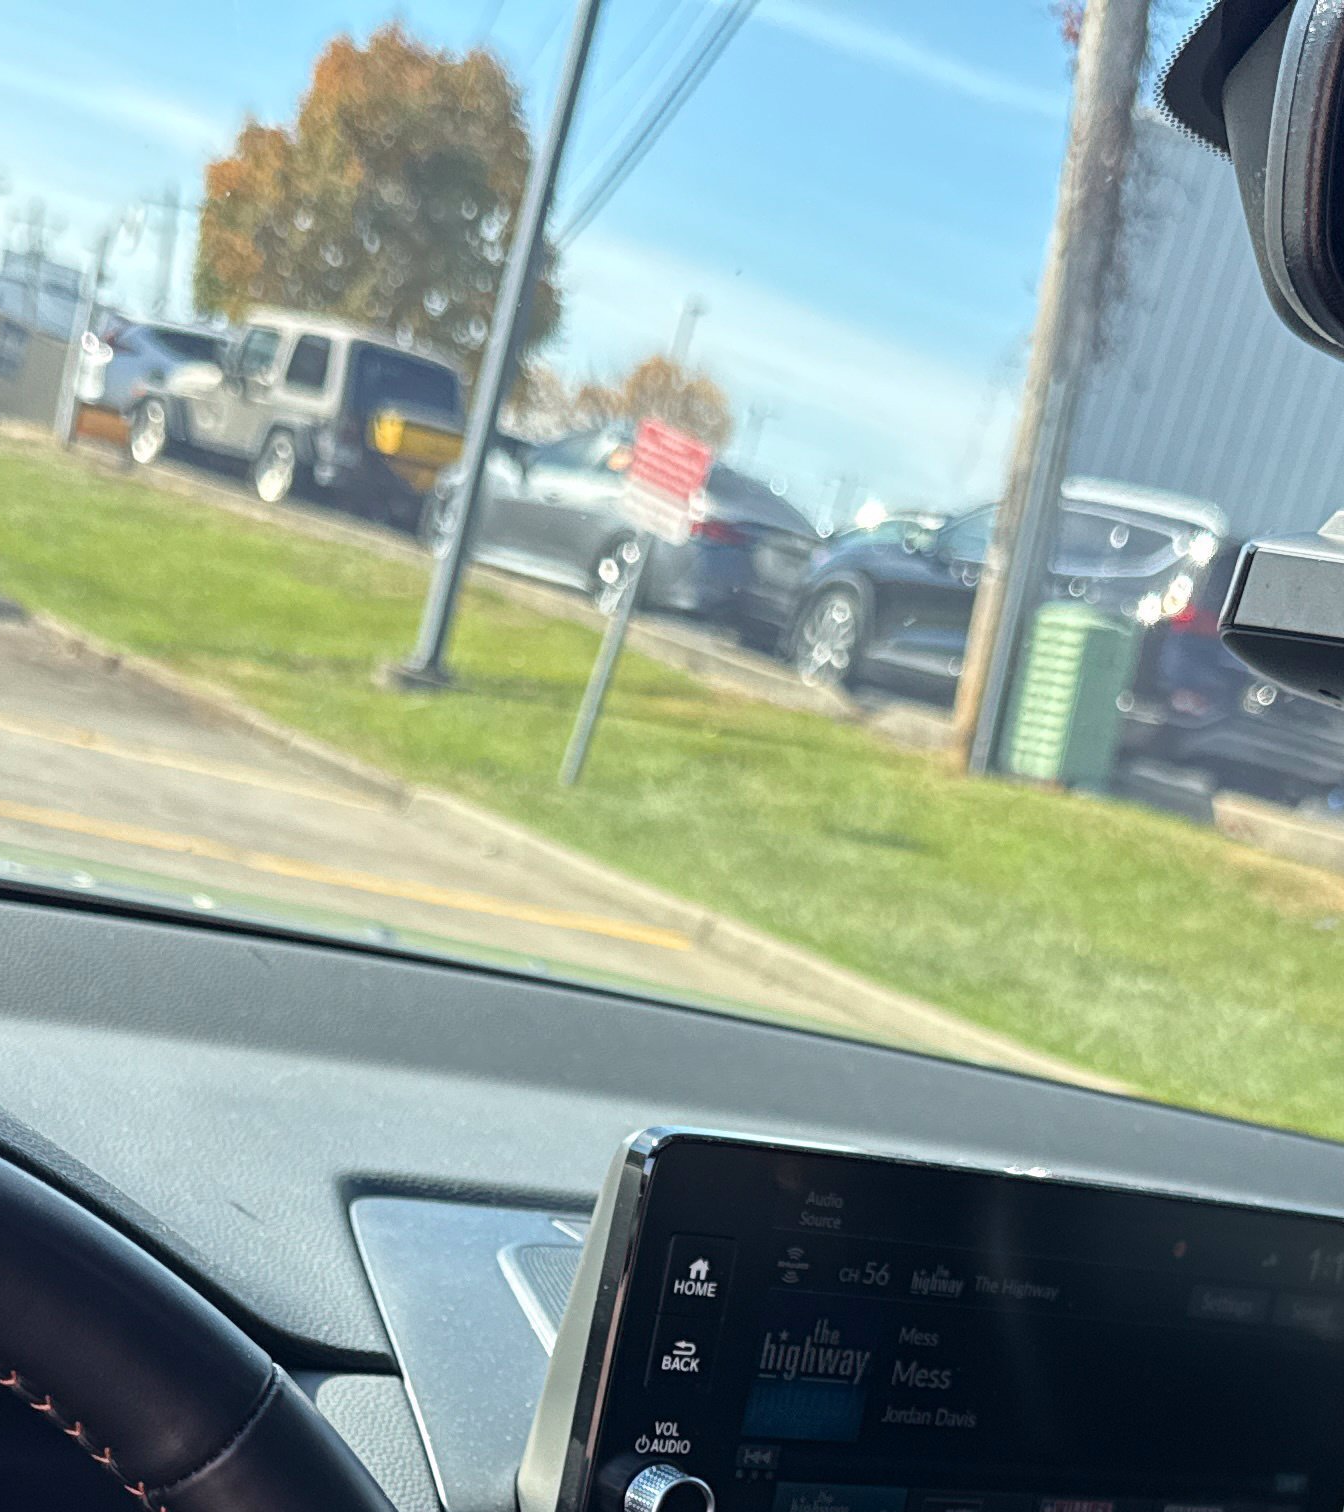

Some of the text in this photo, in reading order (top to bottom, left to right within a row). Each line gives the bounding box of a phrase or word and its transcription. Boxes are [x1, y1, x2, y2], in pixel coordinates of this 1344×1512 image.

[805, 1190, 844, 1208] Audio
[798, 1211, 843, 1230] Source
[838, 1260, 891, 1287] CH 56
[673, 1278, 718, 1299] HOME
[812, 1317, 841, 1347] the
[897, 1325, 940, 1348] Mess
[660, 1354, 701, 1373] BACK
[759, 1330, 872, 1386] highway
[890, 1359, 953, 1391] Mess
[880, 1404, 978, 1429] Jordan Davis
[654, 1420, 680, 1437] VOL
[649, 1438, 692, 1455] AUDIO
